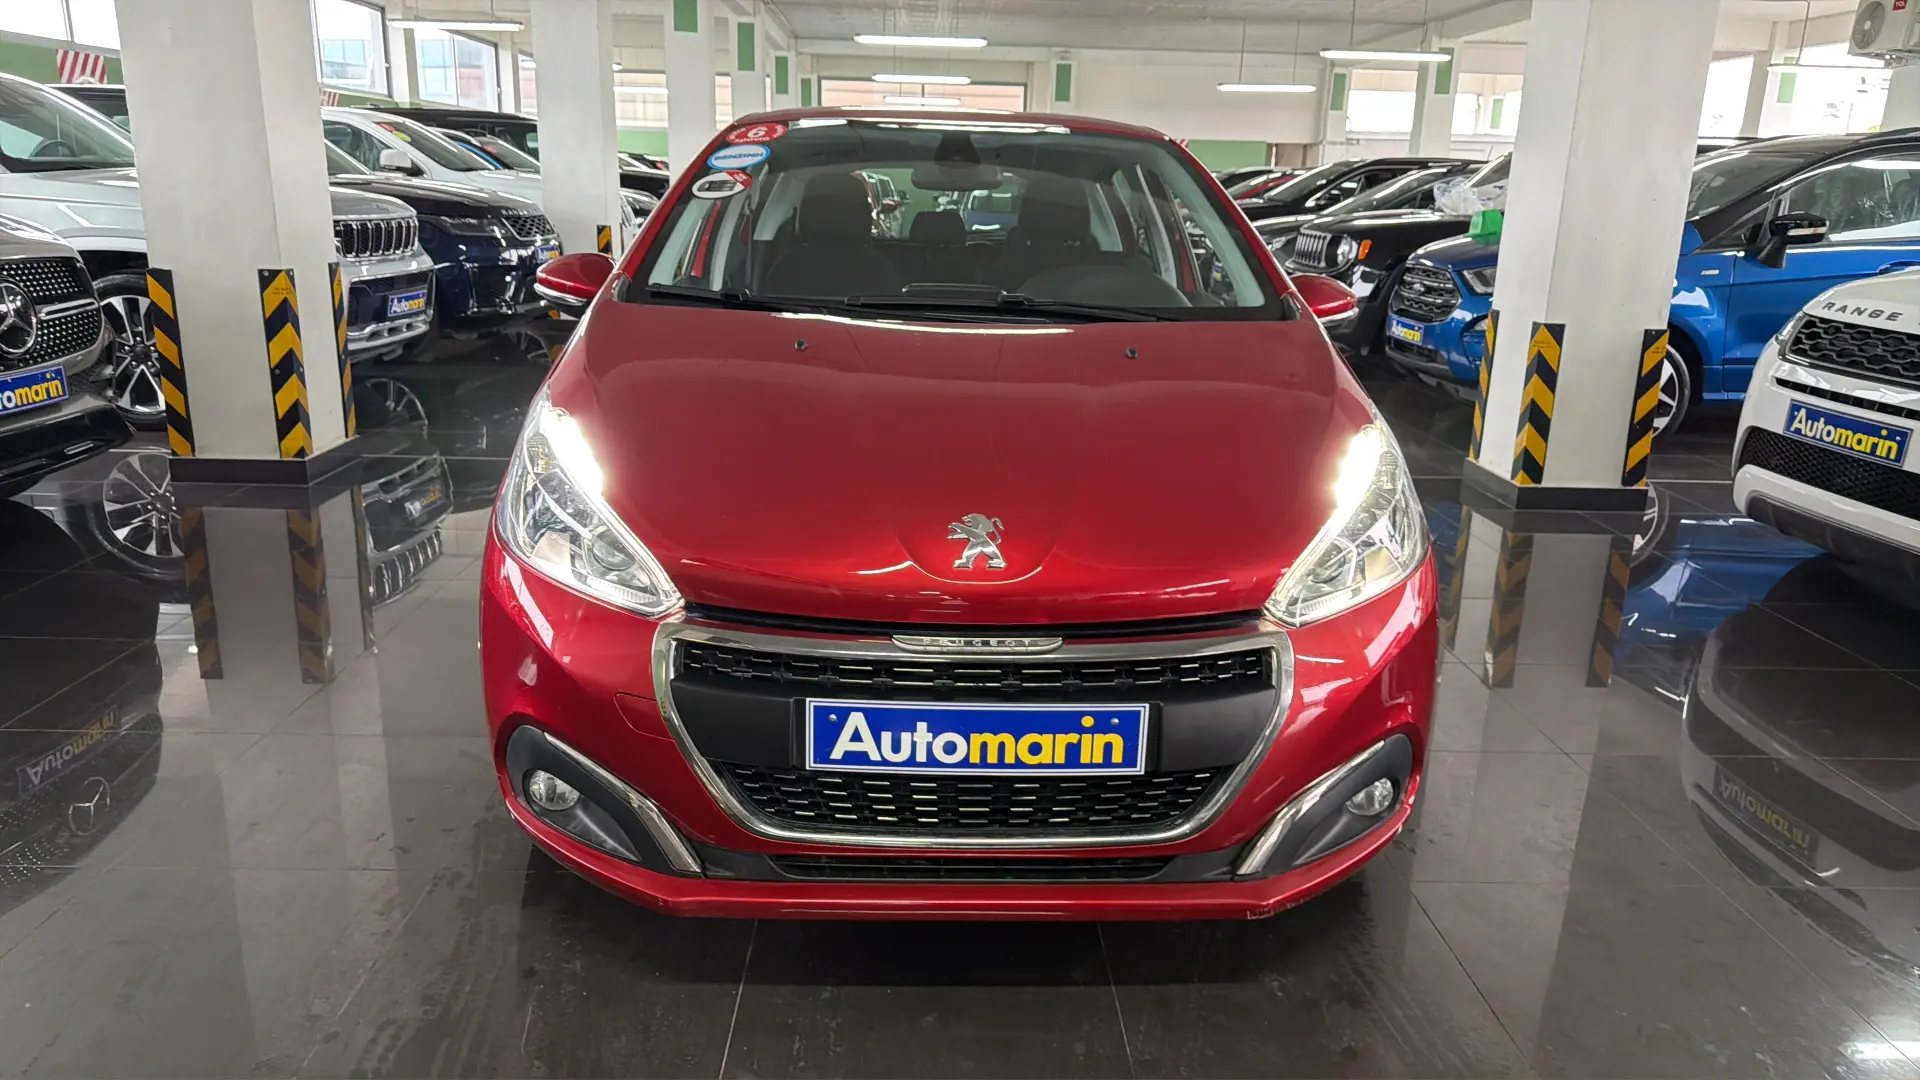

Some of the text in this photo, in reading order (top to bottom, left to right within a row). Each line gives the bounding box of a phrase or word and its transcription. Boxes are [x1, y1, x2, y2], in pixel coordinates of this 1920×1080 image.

[747, 126, 768, 138] 6
[1821, 301, 1904, 322] RANGE
[1790, 407, 1899, 460] Automarin
[923, 637, 1032, 647] PEUGEOT
[829, 711, 1123, 765] Automarin
